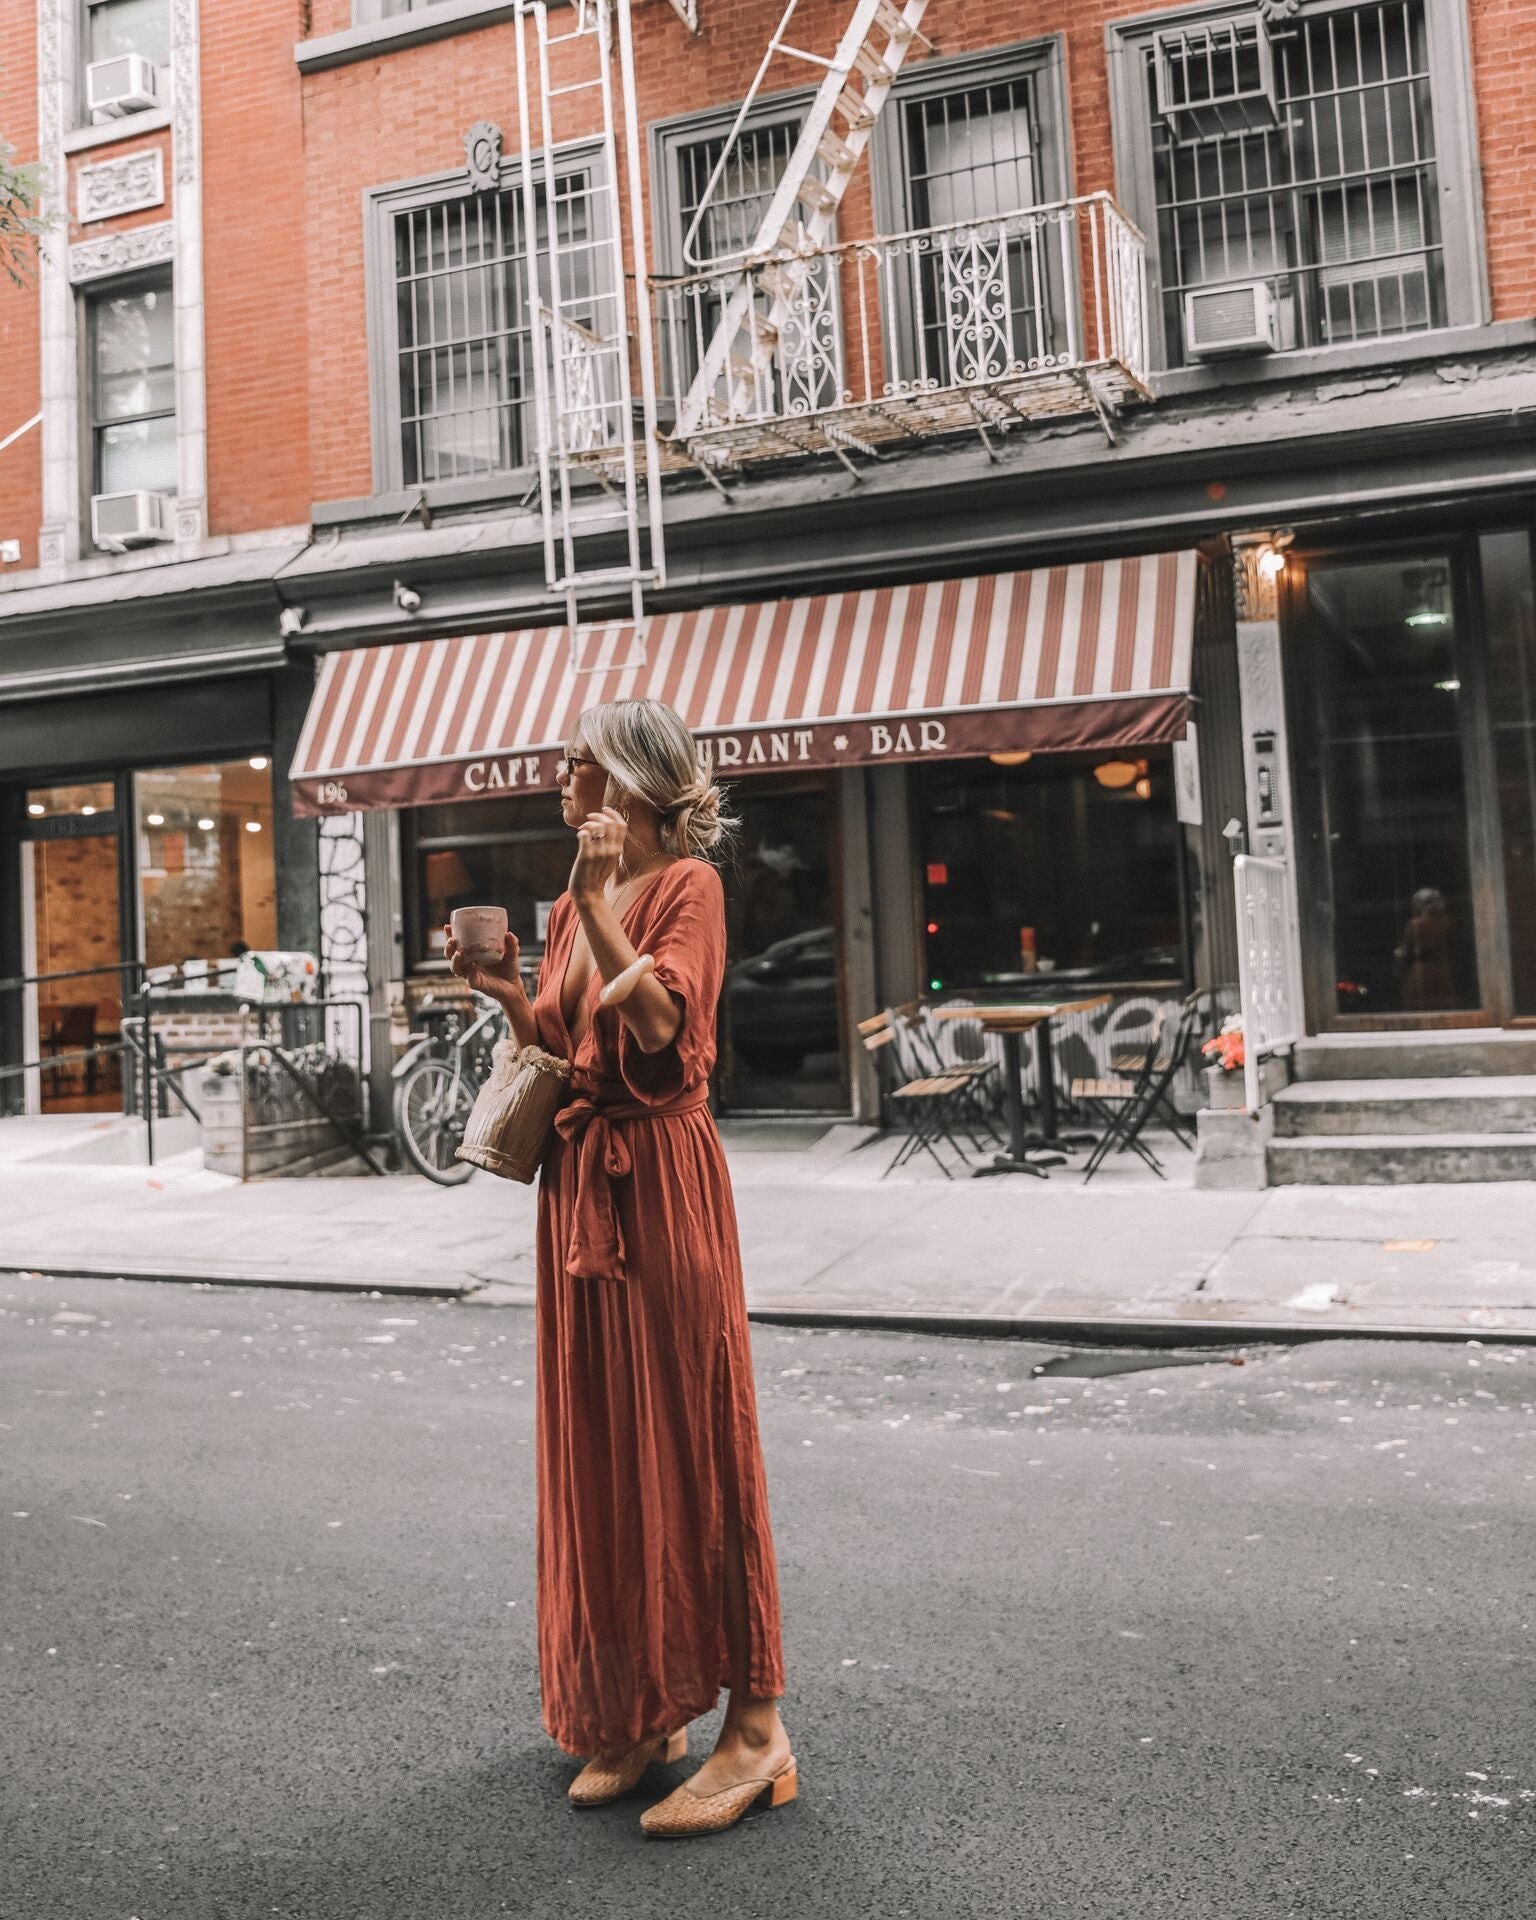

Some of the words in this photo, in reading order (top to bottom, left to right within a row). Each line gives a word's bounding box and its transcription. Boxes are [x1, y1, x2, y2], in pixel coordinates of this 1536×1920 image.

[464, 756, 541, 792] CAFE
[696, 729, 814, 767] URANT
[870, 720, 948, 755] BAR
